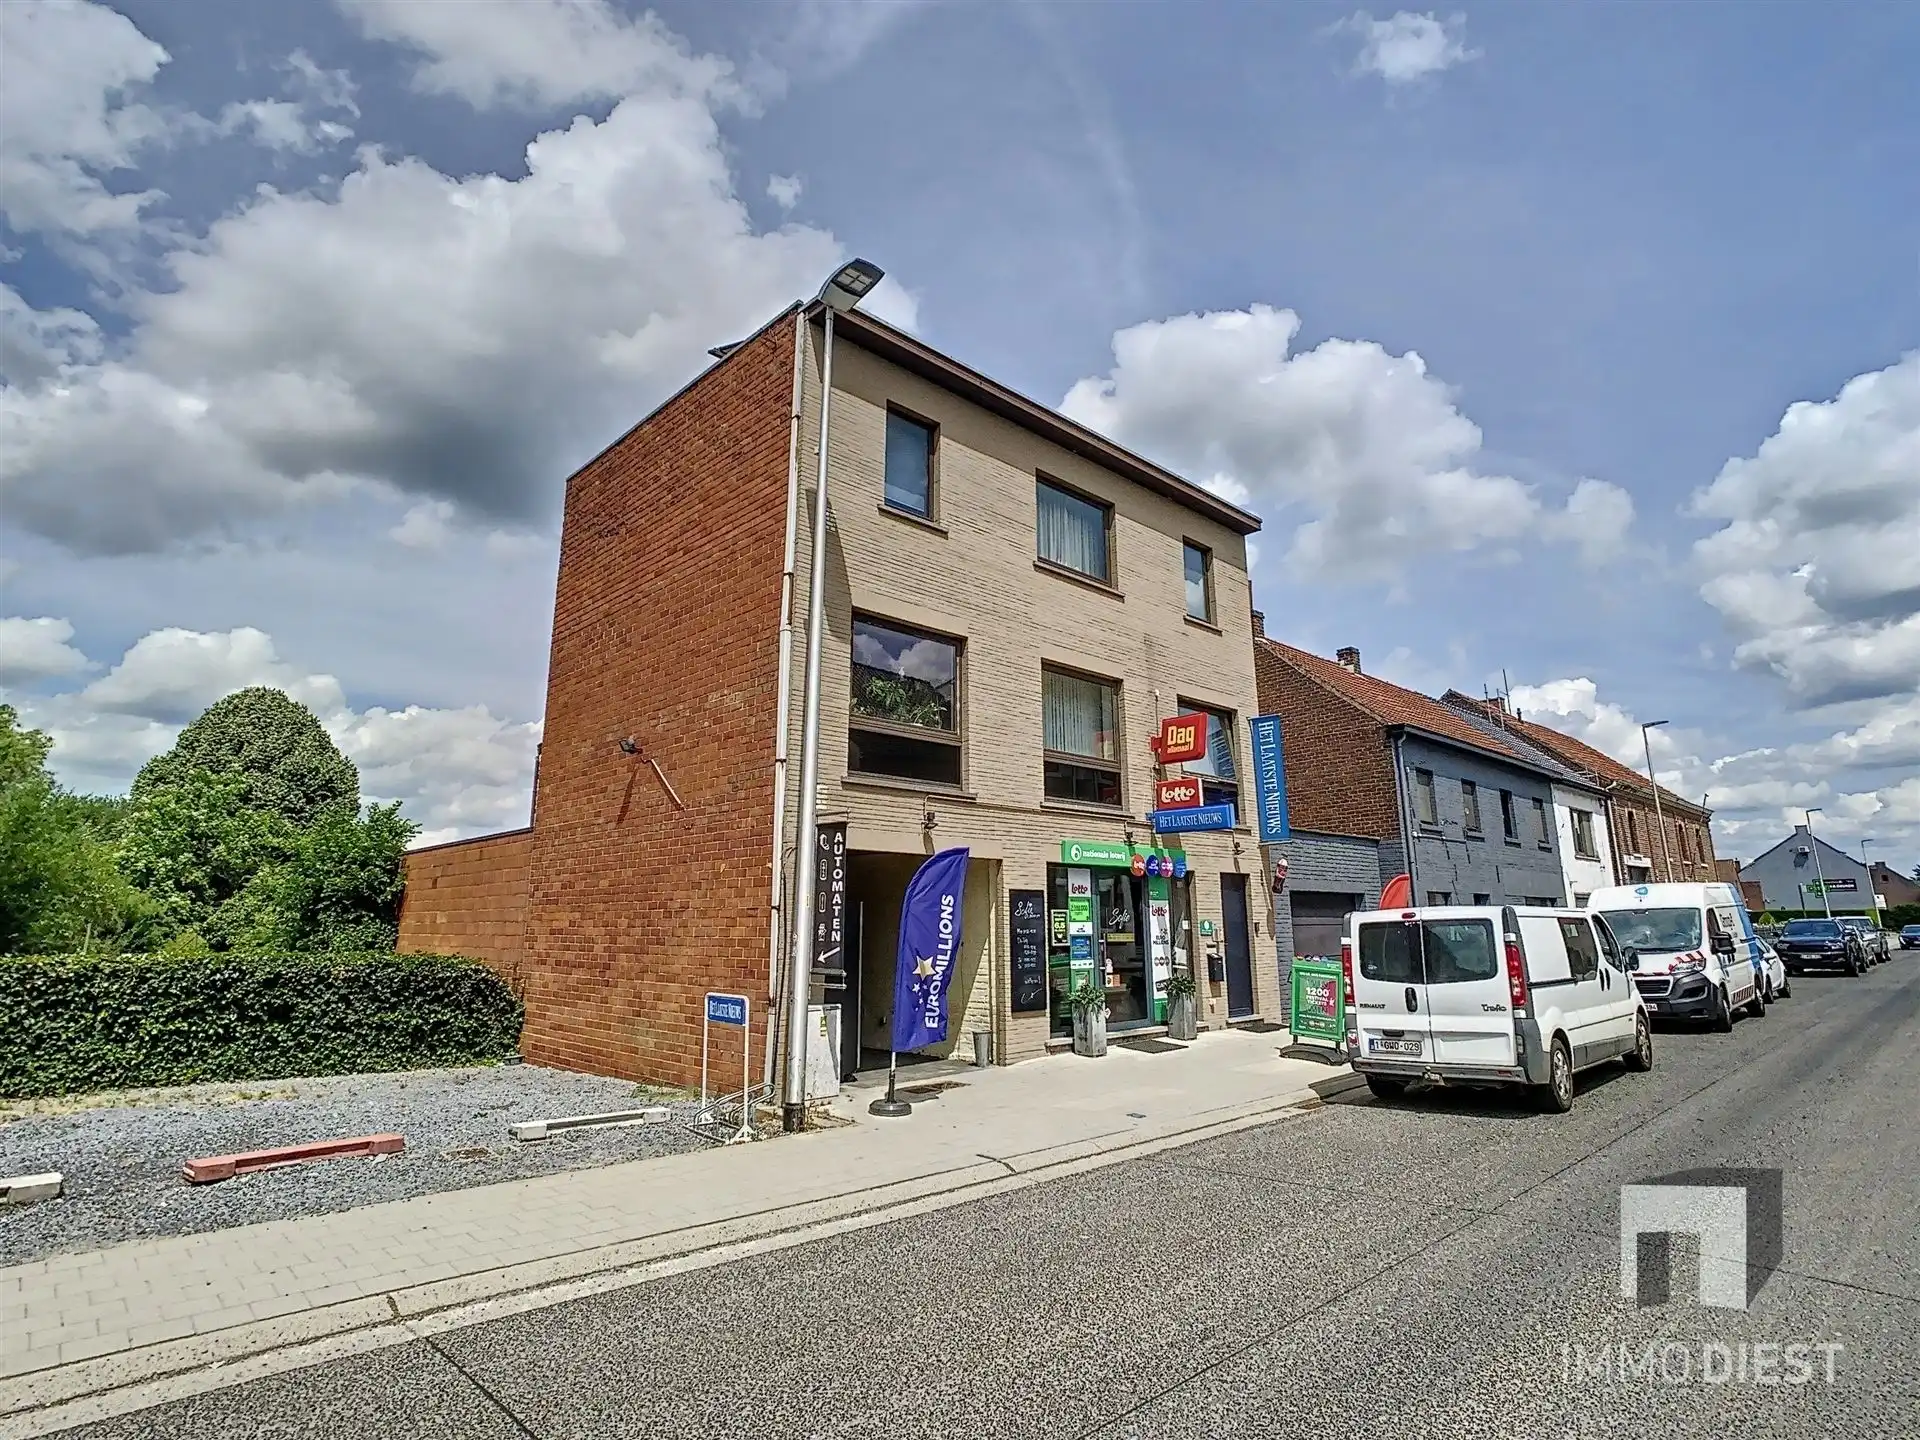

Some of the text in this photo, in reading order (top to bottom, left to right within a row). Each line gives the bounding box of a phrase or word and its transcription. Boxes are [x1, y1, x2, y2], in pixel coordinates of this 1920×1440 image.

[1167, 725, 1196, 751] Dag
[1258, 721, 1281, 835] HET LAATSTE NIEUWS
[1159, 812, 1223, 828] HET LAATSTE NIEUWS
[1082, 850, 1126, 862] nationale loterij
[831, 832, 844, 942] AUTOMATEN
[1109, 908, 1130, 929] Sofie
[925, 894, 954, 1029] EUROMILLIONS
[1306, 987, 1330, 997] 1200
[1481, 1004, 1507, 1012] Trafic
